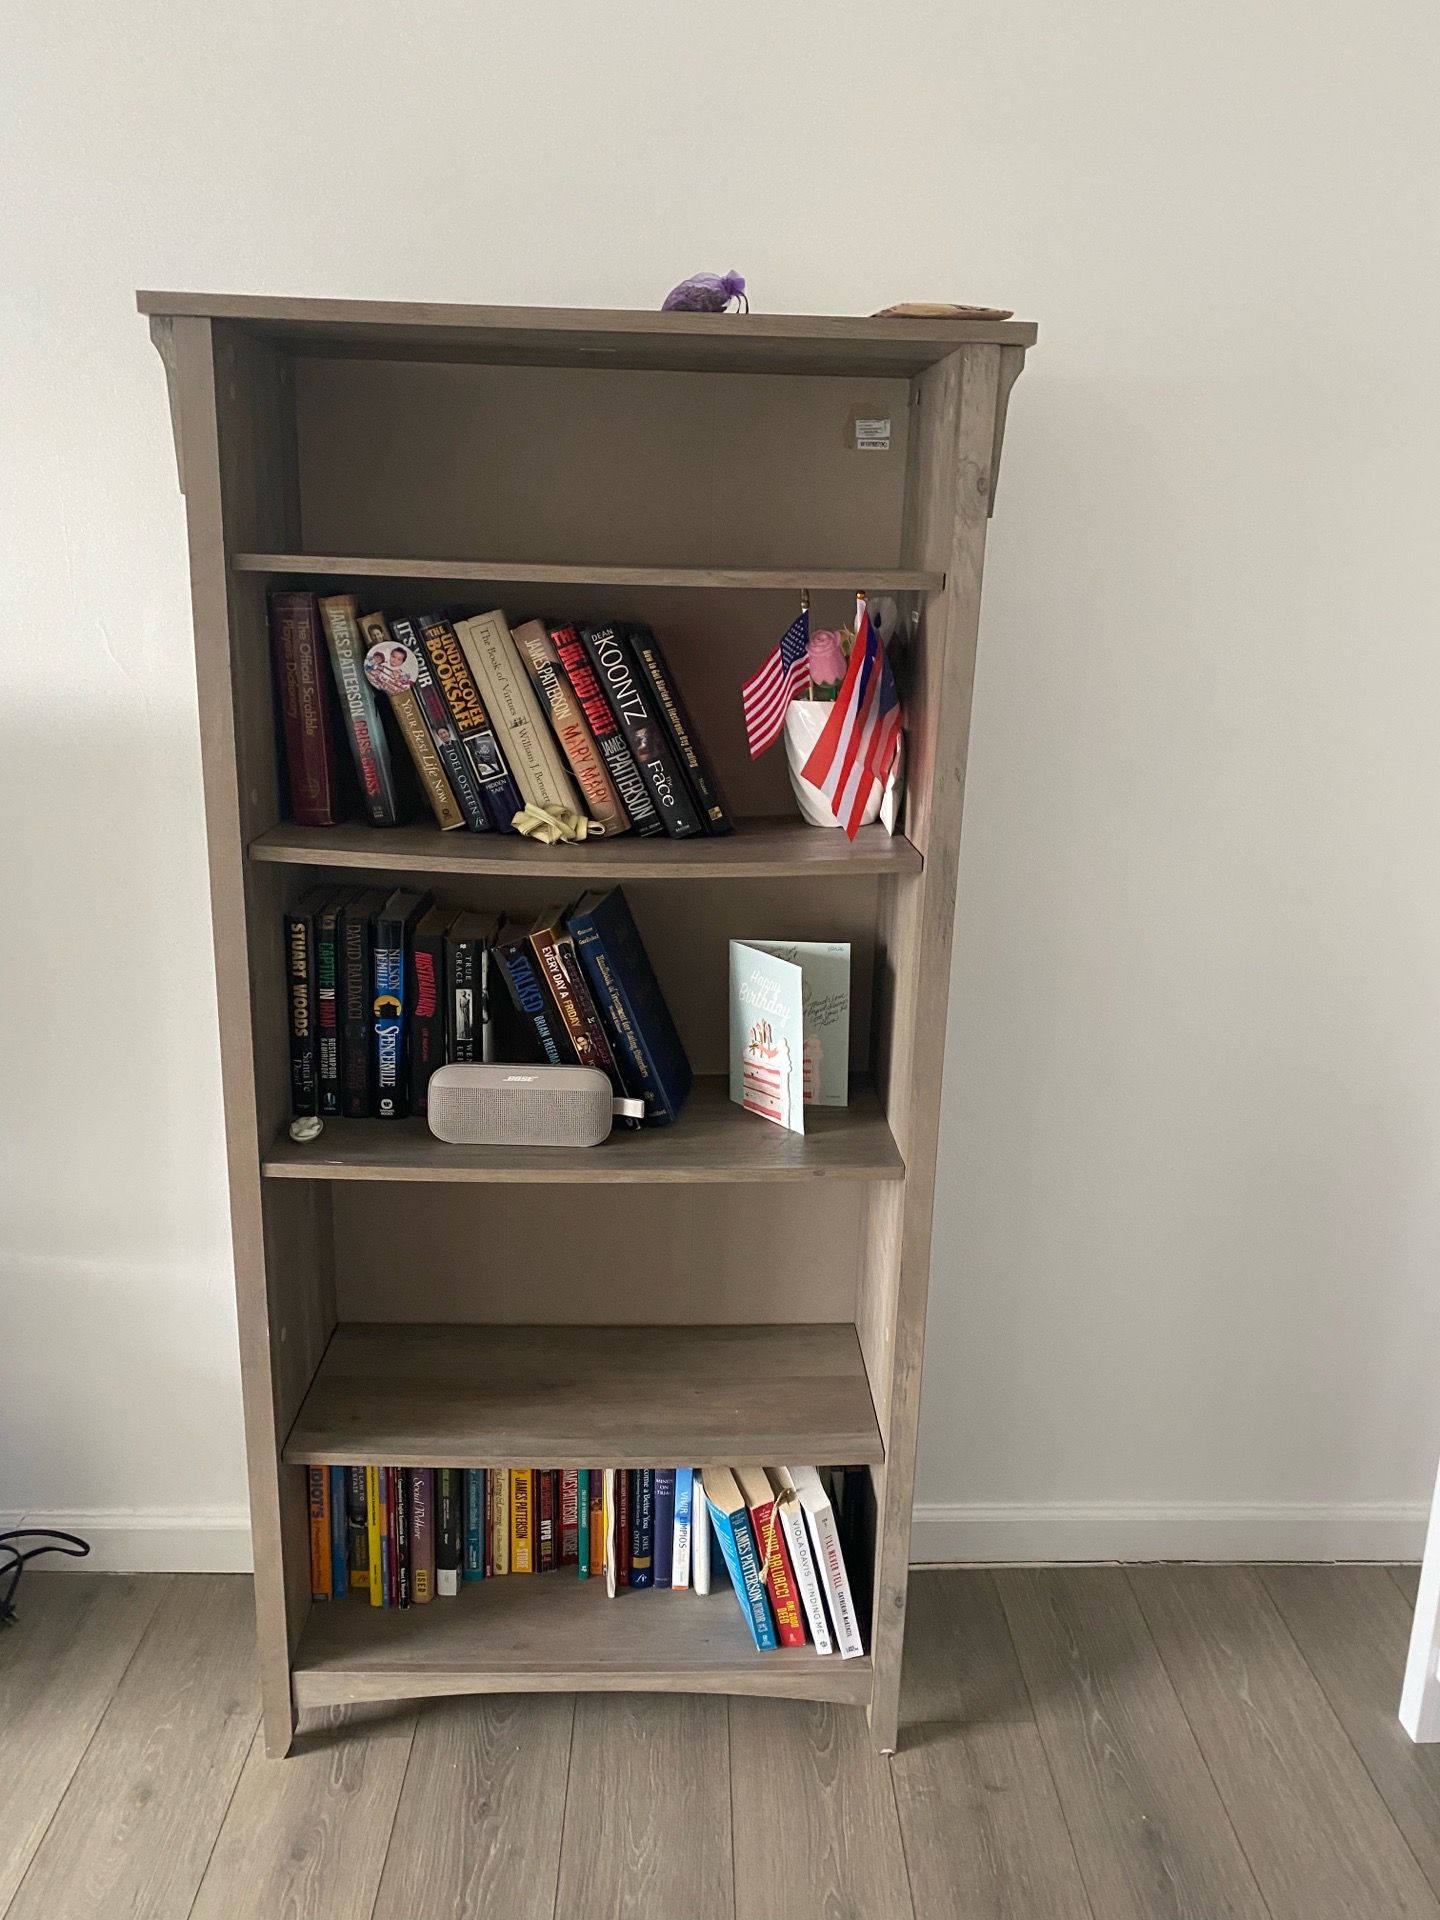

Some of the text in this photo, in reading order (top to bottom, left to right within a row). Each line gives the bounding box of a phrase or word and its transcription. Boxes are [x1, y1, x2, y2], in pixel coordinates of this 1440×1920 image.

[330, 609, 350, 648] JAMES
[427, 623, 447, 639] THE
[551, 625, 578, 647] THE
[591, 628, 613, 642] DEAN
[298, 619, 320, 736] The Official Scrabble
[397, 621, 416, 647] IT'S
[408, 647, 433, 688] YOUR
[523, 635, 573, 721] JAMES PATTERSON
[643, 648, 655, 663] How
[651, 668, 663, 681] Get
[339, 649, 365, 717] PATTERSON
[427, 638, 472, 731] BOOKSAFE
[441, 633, 485, 727] UNDERCOVER
[558, 641, 618, 738] BIG BAD WOLF
[594, 634, 648, 725] KOONTZ
[656, 679, 671, 702] Started
[479, 628, 492, 646] The
[487, 647, 501, 671] Book
[497, 671, 506, 684] of
[502, 684, 516, 716] Virtues
[518, 728, 537, 762] William
[535, 770, 551, 803] Bennett
[667, 707, 683, 735] Electronic
[412, 729, 429, 753] Best
[423, 753, 439, 778] Life
[560, 723, 611, 808] MARY MARY
[601, 734, 627, 757] JAMES
[683, 746, 699, 768] Trading
[446, 747, 463, 774] JOEL
[457, 774, 480, 815] OSTEEN
[607, 749, 655, 822] PATTERSON
[648, 760, 674, 808] Face
[291, 923, 308, 1037] STUART WOODS
[319, 943, 335, 1028] CAPTIVE IN IRAN
[346, 924, 363, 1019] DAVID BALDACCI
[374, 949, 388, 989] DEMILLE
[388, 948, 400, 990] NELSON
[414, 951, 437, 1018] NOSTRADAMUS
[455, 952, 463, 984] GRACE
[464, 956, 472, 981] TRUE
[506, 955, 544, 1013] STALKED
[541, 946, 583, 1029] EVERY DAY A FRIDAY
[750, 970, 782, 994] Happy
[595, 954, 611, 985] Handbook
[610, 992, 627, 1020] Treatment
[626, 1030, 638, 1050] Eating
[633, 1050, 649, 1078] Disorders
[739, 982, 791, 1028] Birthday
[328, 1038, 336, 1079] ROSTAMPOUR
[375, 1024, 399, 1087] SPENCERVILLE
[534, 1015, 561, 1065] BRIAN FREEMA
[303, 1051, 312, 1078] Santa
[311, 1468, 323, 1518] IDIOT'S
[413, 1478, 425, 1539] Social Welfare
[515, 1478, 527, 1538] JAMES PATTERSON
[563, 1470, 577, 1524] AMES PATTERSON
[680, 1491, 688, 1514] VIVIR
[541, 1520, 551, 1540] NYPD
[678, 1517, 687, 1548] LIMPIOS
[734, 1526, 750, 1554] JAMES
[762, 1523, 778, 1553] DAVID
[516, 1548, 528, 1568] STORE
[740, 1555, 762, 1603] PATTERSON
[768, 1553, 790, 1599] BALDACCI
[793, 1520, 824, 1634] VIOLA DAVIS FINDING ME
[417, 1572, 425, 1593] USED
[827, 1550, 839, 1572] NEVER
[833, 1573, 842, 1589] TELL
[838, 1591, 848, 1616] CATHERINE
[752, 1602, 766, 1624] JUROR
[758, 1623, 767, 1632] #3
[777, 1607, 788, 1625] DEED
[786, 1601, 799, 1628] ONE GOOD
